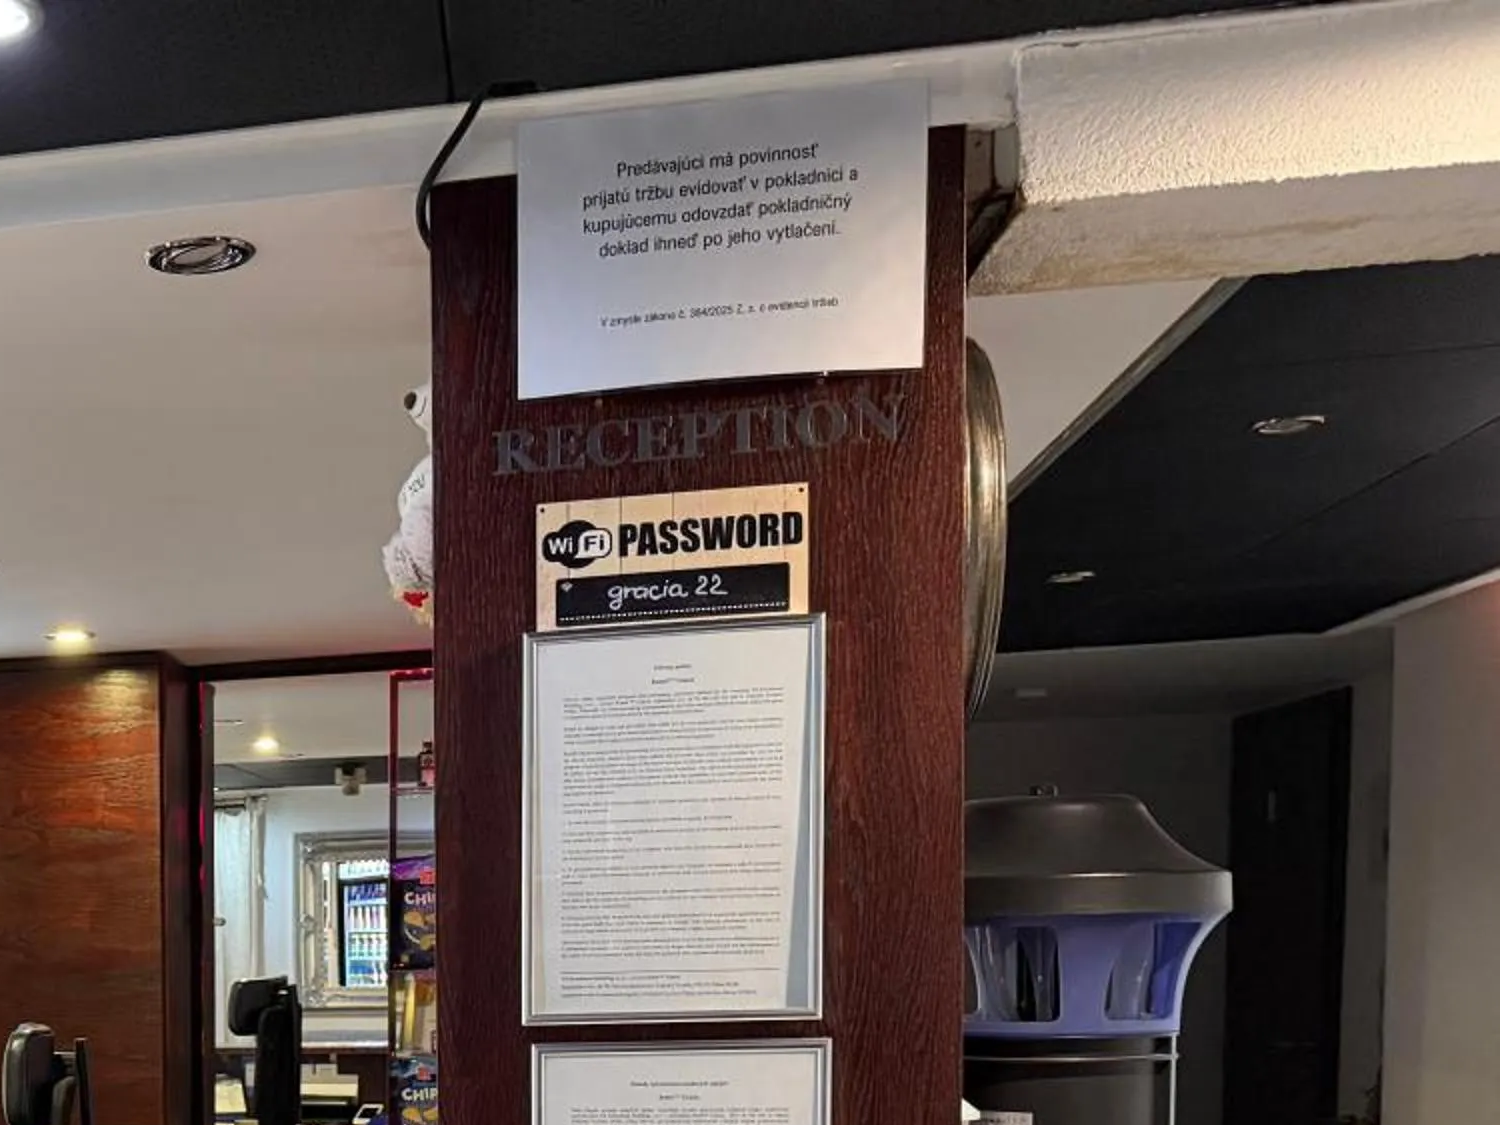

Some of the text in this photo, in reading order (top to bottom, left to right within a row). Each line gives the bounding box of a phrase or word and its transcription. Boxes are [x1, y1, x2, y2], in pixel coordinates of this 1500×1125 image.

[617, 143, 819, 178] Predávajúci má povinnosť
[583, 166, 859, 211] prijatú tržbu evidovať v pokladnici a
[583, 192, 852, 235] kupujúcemu odovzdať pokladničný
[599, 238, 649, 257] doklad
[653, 233, 698, 251] ihneď
[703, 234, 722, 250] po
[726, 228, 761, 248] jeho
[492, 392, 908, 477] RECEPTION
[545, 511, 803, 562] WiFi PASSWORD
[607, 574, 728, 611] gracia 22
[403, 891, 436, 905] CHI
[401, 1087, 438, 1101] CHIP
